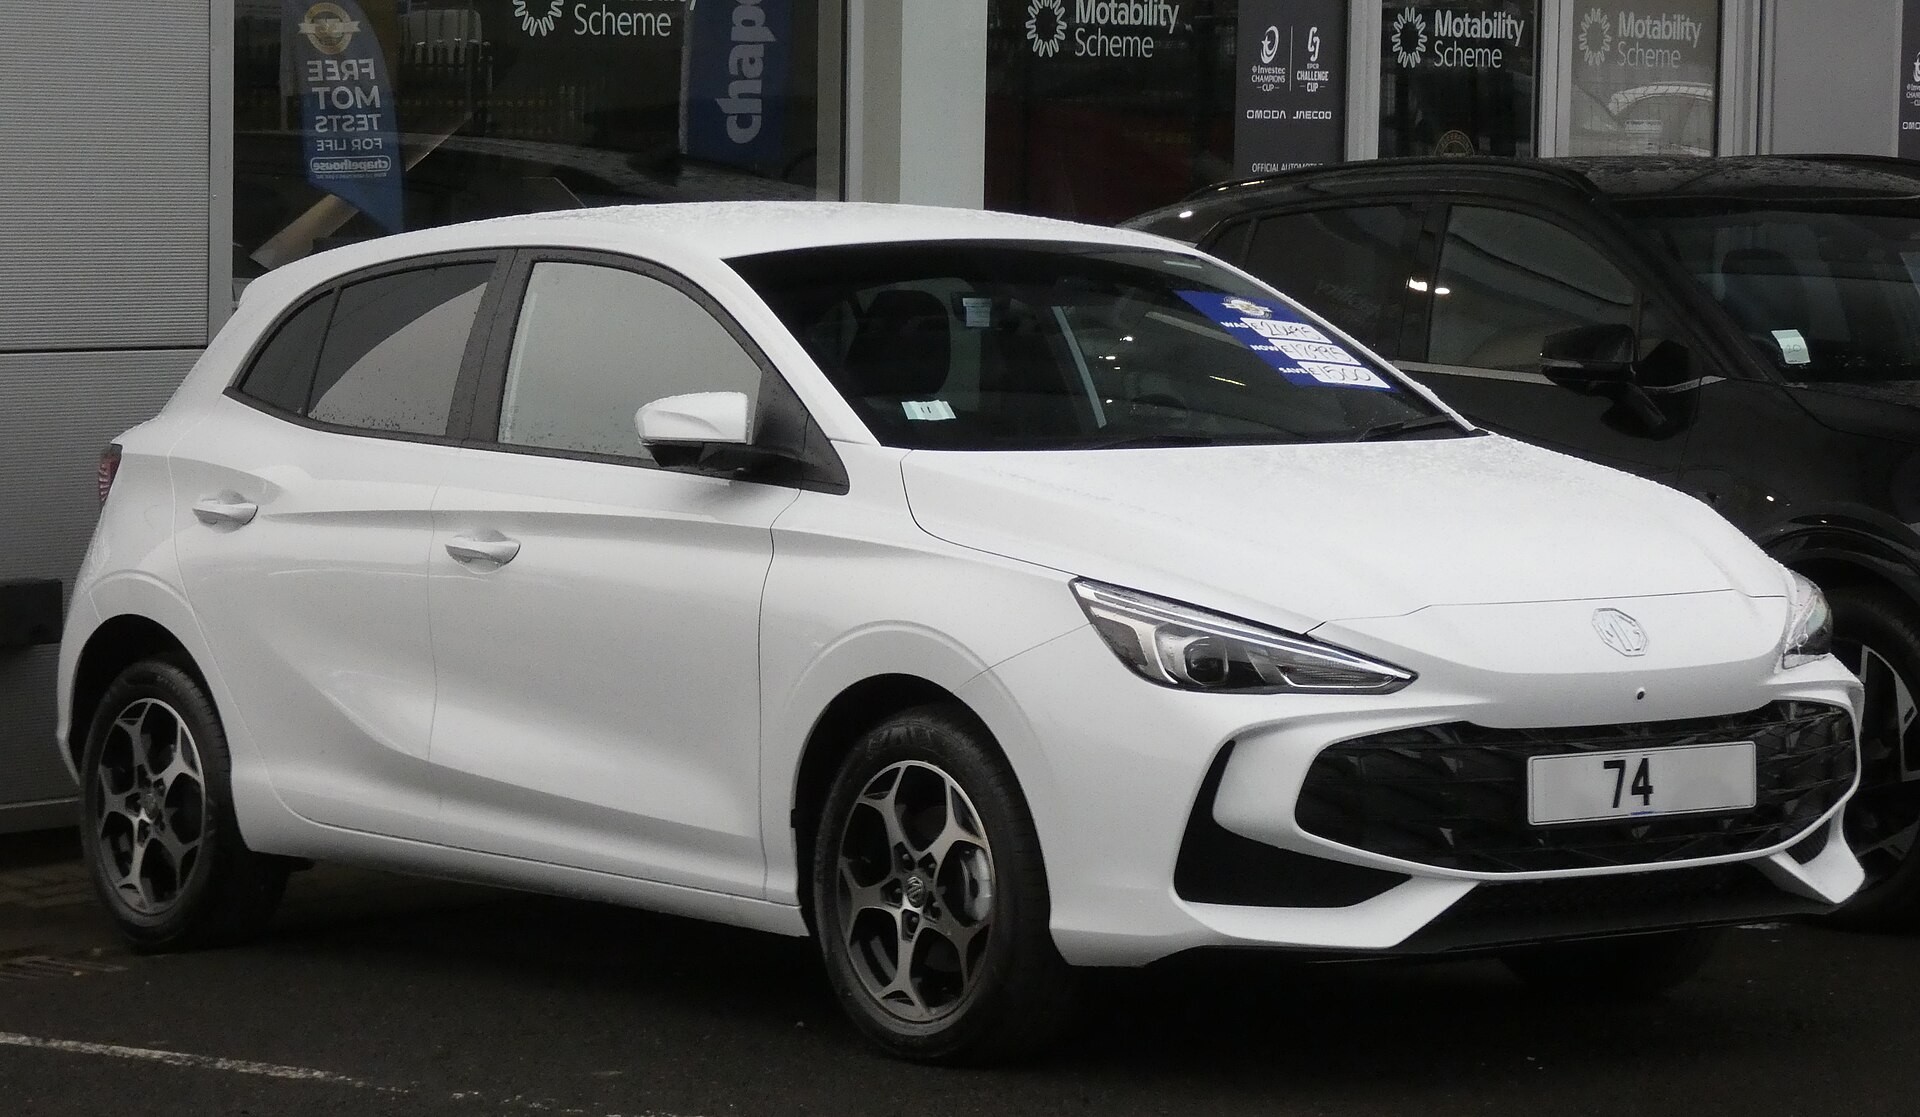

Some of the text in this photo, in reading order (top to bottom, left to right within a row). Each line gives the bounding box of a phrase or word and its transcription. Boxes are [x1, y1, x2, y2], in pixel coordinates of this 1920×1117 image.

[574, 3, 672, 37] Scheme
[1075, 0, 1180, 34] Motability
[1434, 9, 1525, 47] Motability
[1618, 11, 1702, 48] Motability
[1074, 28, 1154, 58] Scheme
[1434, 40, 1503, 69] Scheme
[1617, 41, 1681, 68] Scheme
[1257, 65, 1286, 75] Investec
[1251, 74, 1286, 83] CHAMPIONS
[1296, 70, 1330, 82] CHALLENGE
[1261, 83, 1275, 92] CUP
[1306, 82, 1319, 92] CUP
[1246, 109, 1332, 120] OMODA JAECOO
[1251, 163, 1279, 173] OFFICIAL
[1220, 321, 1250, 329] WAS
[1249, 344, 1280, 352] NOW
[1278, 367, 1309, 375] SAVE
[1603, 757, 1654, 809] 74
